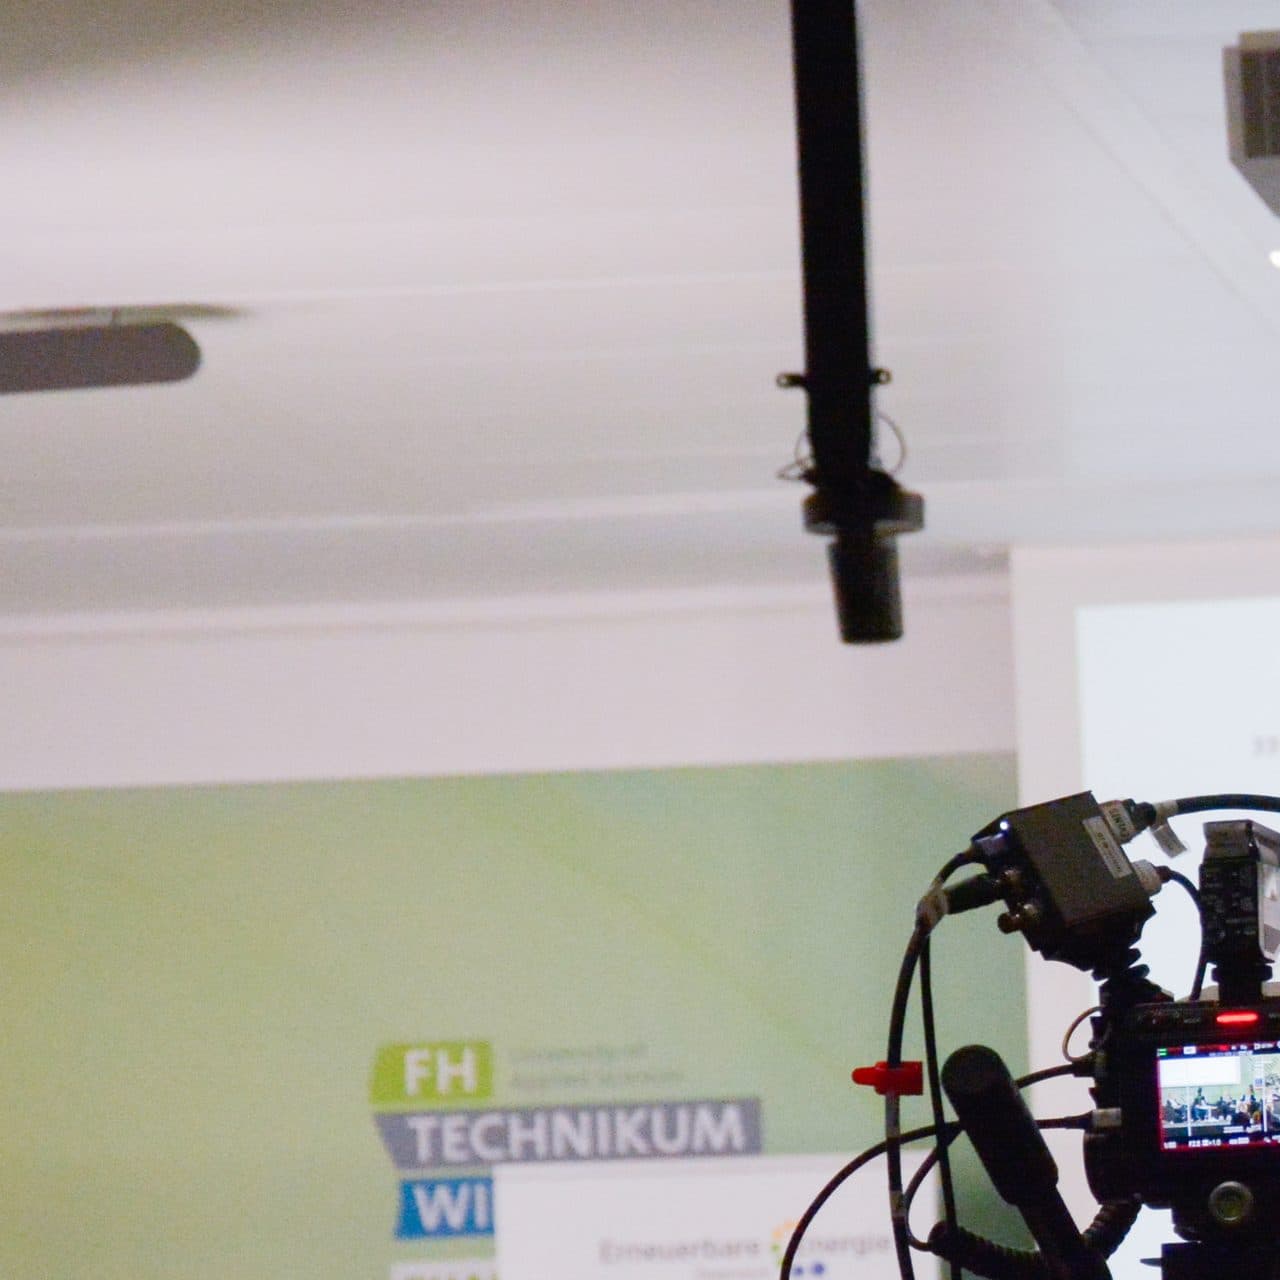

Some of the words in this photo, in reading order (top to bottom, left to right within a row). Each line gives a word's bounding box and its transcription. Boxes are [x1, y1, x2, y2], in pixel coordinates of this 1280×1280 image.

[403, 1048, 478, 1096] FH
[406, 1103, 745, 1164] TECHNIKUM
[413, 1184, 493, 1232] WI
